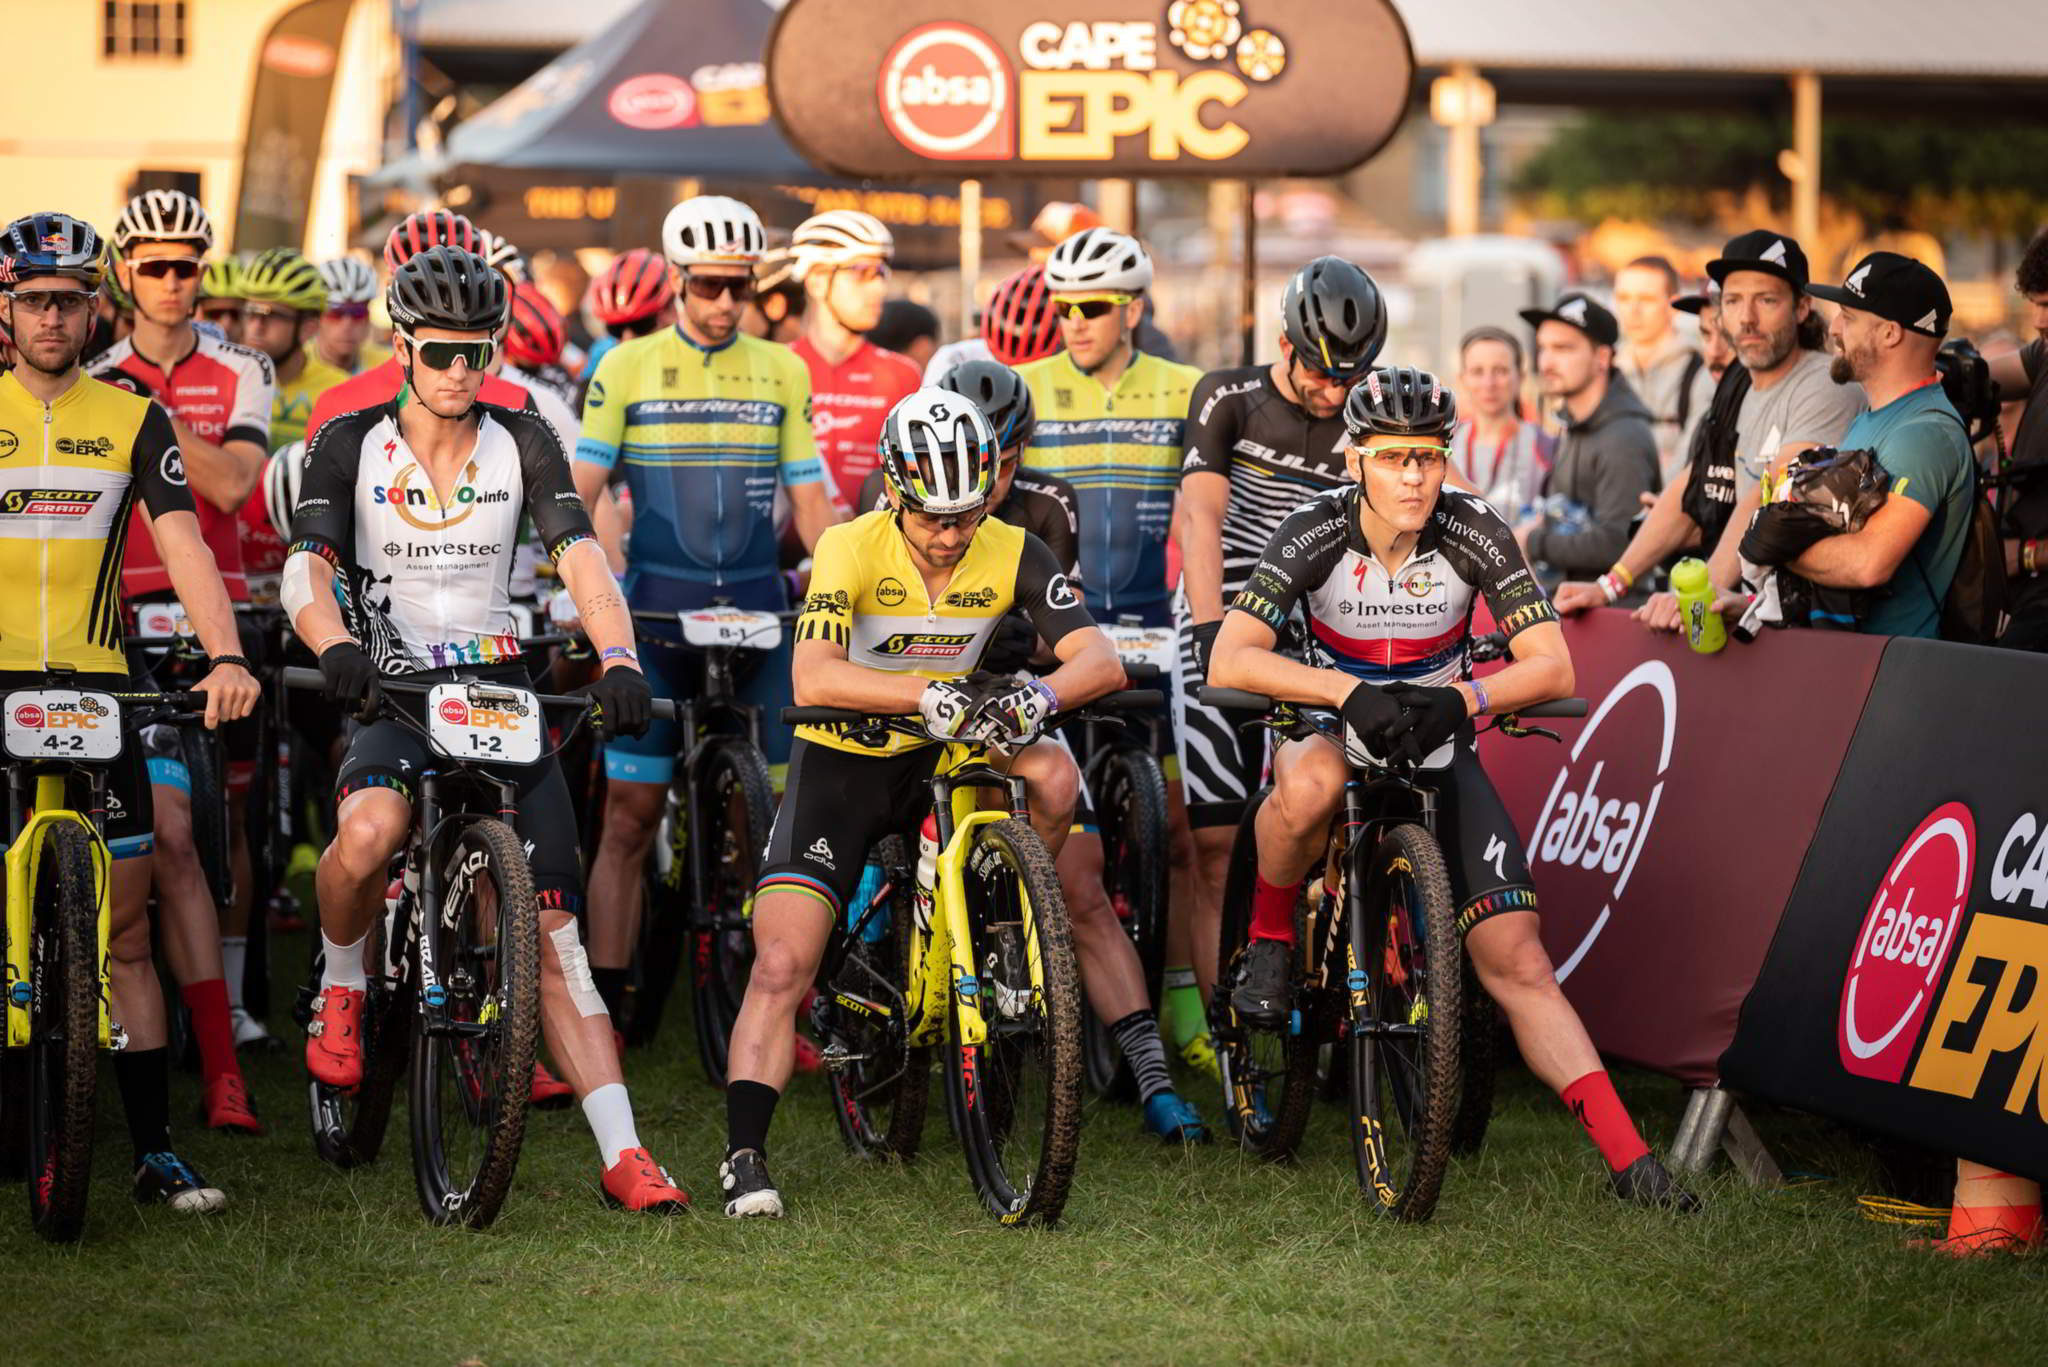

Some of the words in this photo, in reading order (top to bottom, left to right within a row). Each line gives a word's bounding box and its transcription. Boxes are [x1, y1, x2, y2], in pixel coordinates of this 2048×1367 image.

[1020, 21, 1156, 70] CAPE
[900, 65, 991, 106] absa
[1020, 69, 1250, 160] EPIC
[635, 400, 781, 416] SILVERBACK
[1033, 419, 1180, 436] SILVERBACK
[76, 445, 107, 457] EPIC
[29, 491, 98, 501] SCOTT
[32, 504, 87, 513] SRAM
[1292, 513, 1348, 550] Investec
[1447, 515, 1507, 567] Investec
[407, 542, 502, 558] Investec
[406, 563, 433, 571] Asset
[436, 561, 490, 571] Management
[810, 593, 833, 601] CAPE
[878, 588, 904, 597] absa
[806, 601, 845, 616] EPIC
[962, 598, 992, 608] EPIC
[1358, 600, 1449, 616] Investec
[1355, 621, 1381, 629] Asset
[1384, 620, 1438, 629] Management
[910, 634, 971, 644] SCOTT
[911, 647, 961, 655] SRAM
[18, 711, 41, 719] absa
[47, 703, 78, 712] CAPE
[443, 706, 464, 715] absa
[47, 711, 99, 729] EPIC
[471, 709, 521, 731] EPIC
[43, 735, 84, 750] 4-2
[469, 734, 502, 752] 1-2
[1541, 761, 1641, 873] absa
[1990, 812, 2048, 909] CA
[1869, 887, 1944, 968] absa
[34, 965, 46, 1013] SWISS
[835, 994, 872, 1017] SCOTT
